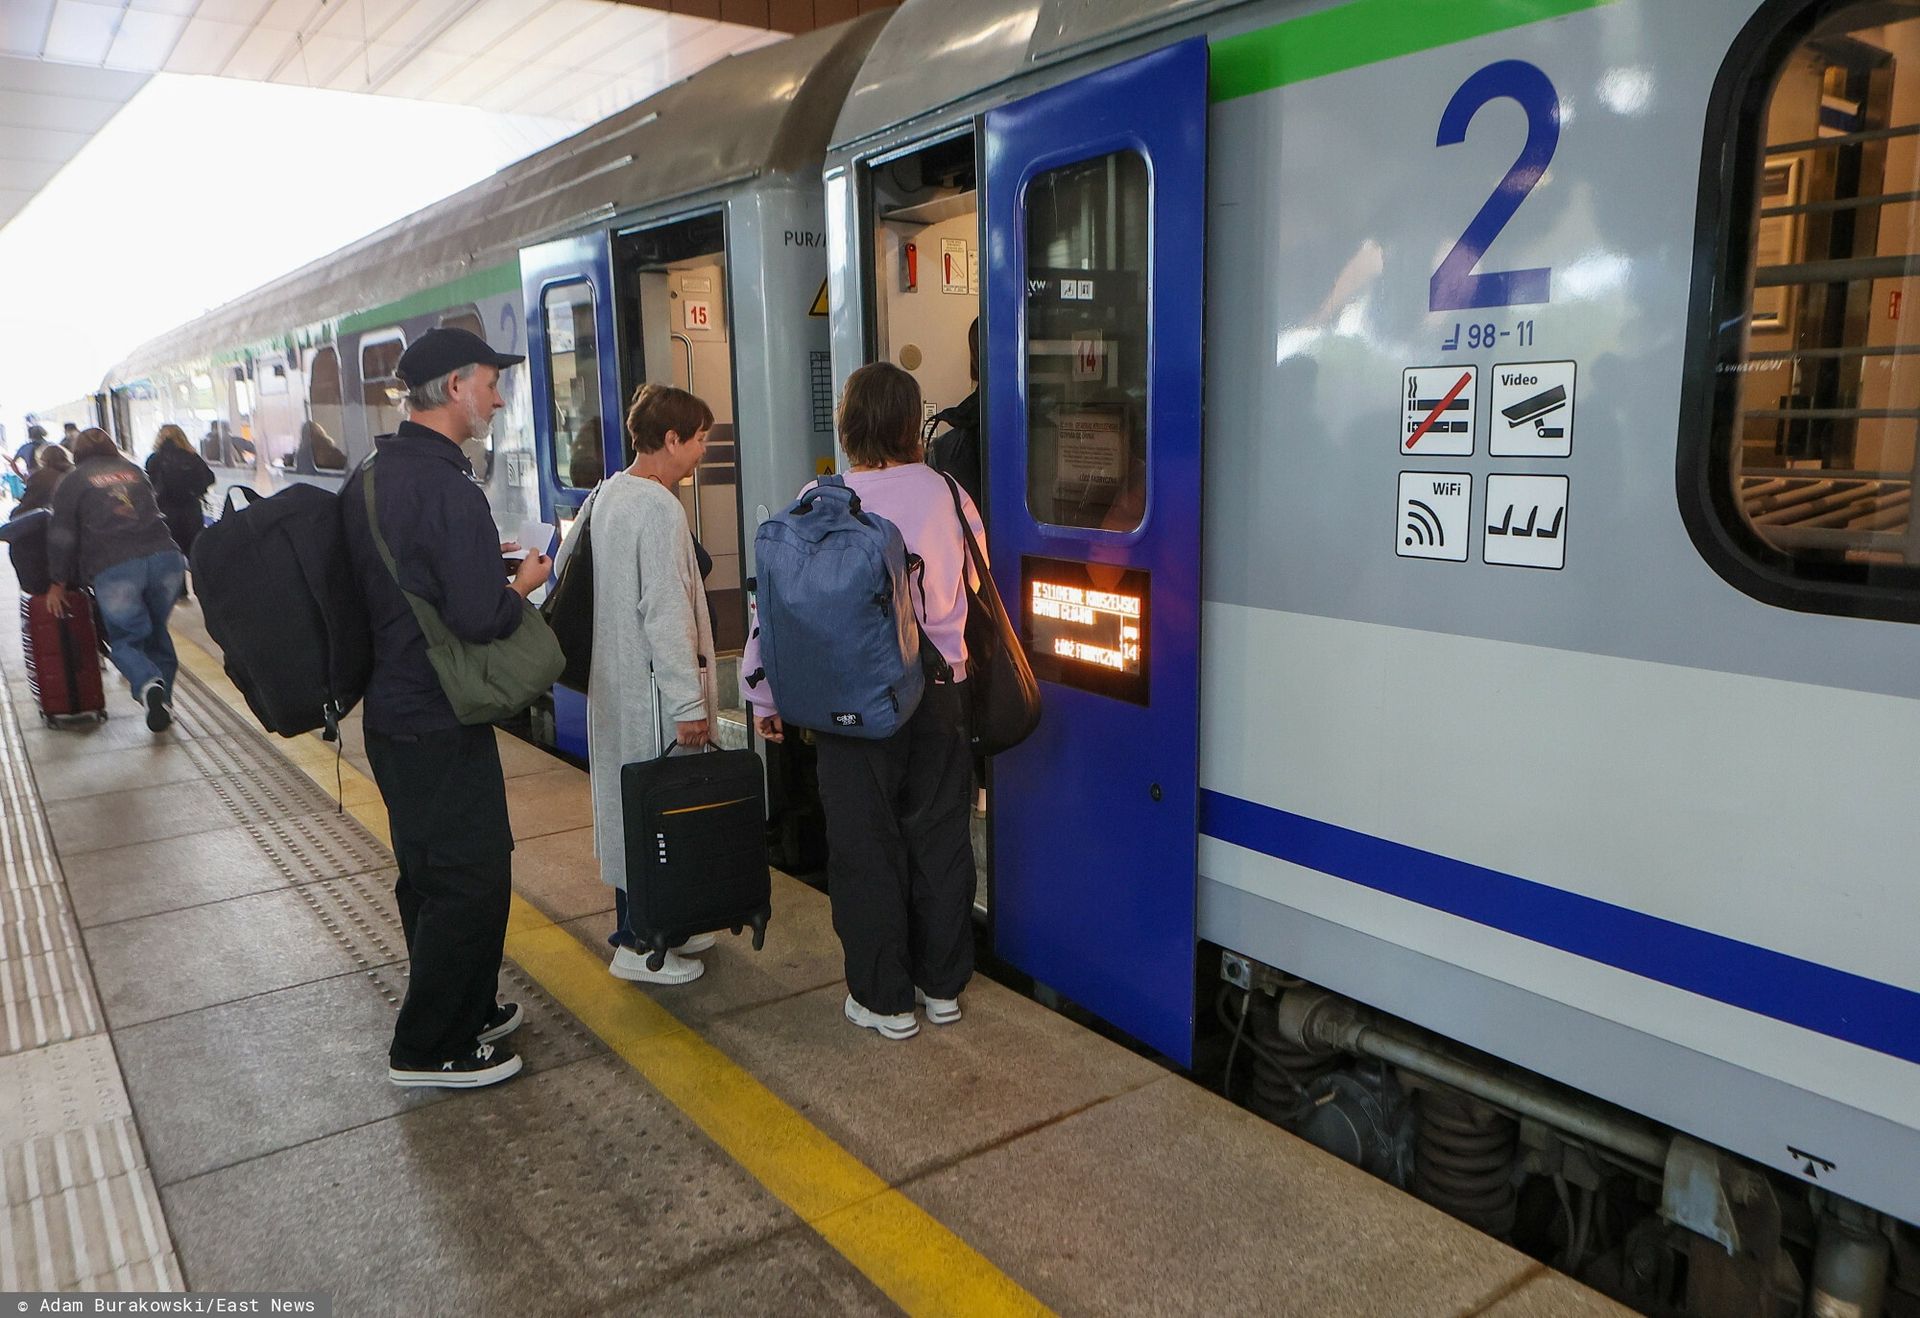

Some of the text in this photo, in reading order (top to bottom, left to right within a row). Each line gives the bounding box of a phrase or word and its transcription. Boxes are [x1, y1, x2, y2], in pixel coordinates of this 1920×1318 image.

[1429, 59, 1560, 312] 2
[691, 306, 707, 324] 15
[1078, 341, 1096, 372] 14
[1501, 373, 1538, 387] Video
[1432, 482, 1461, 496] WiFi
[1123, 643, 1137, 661] 14
